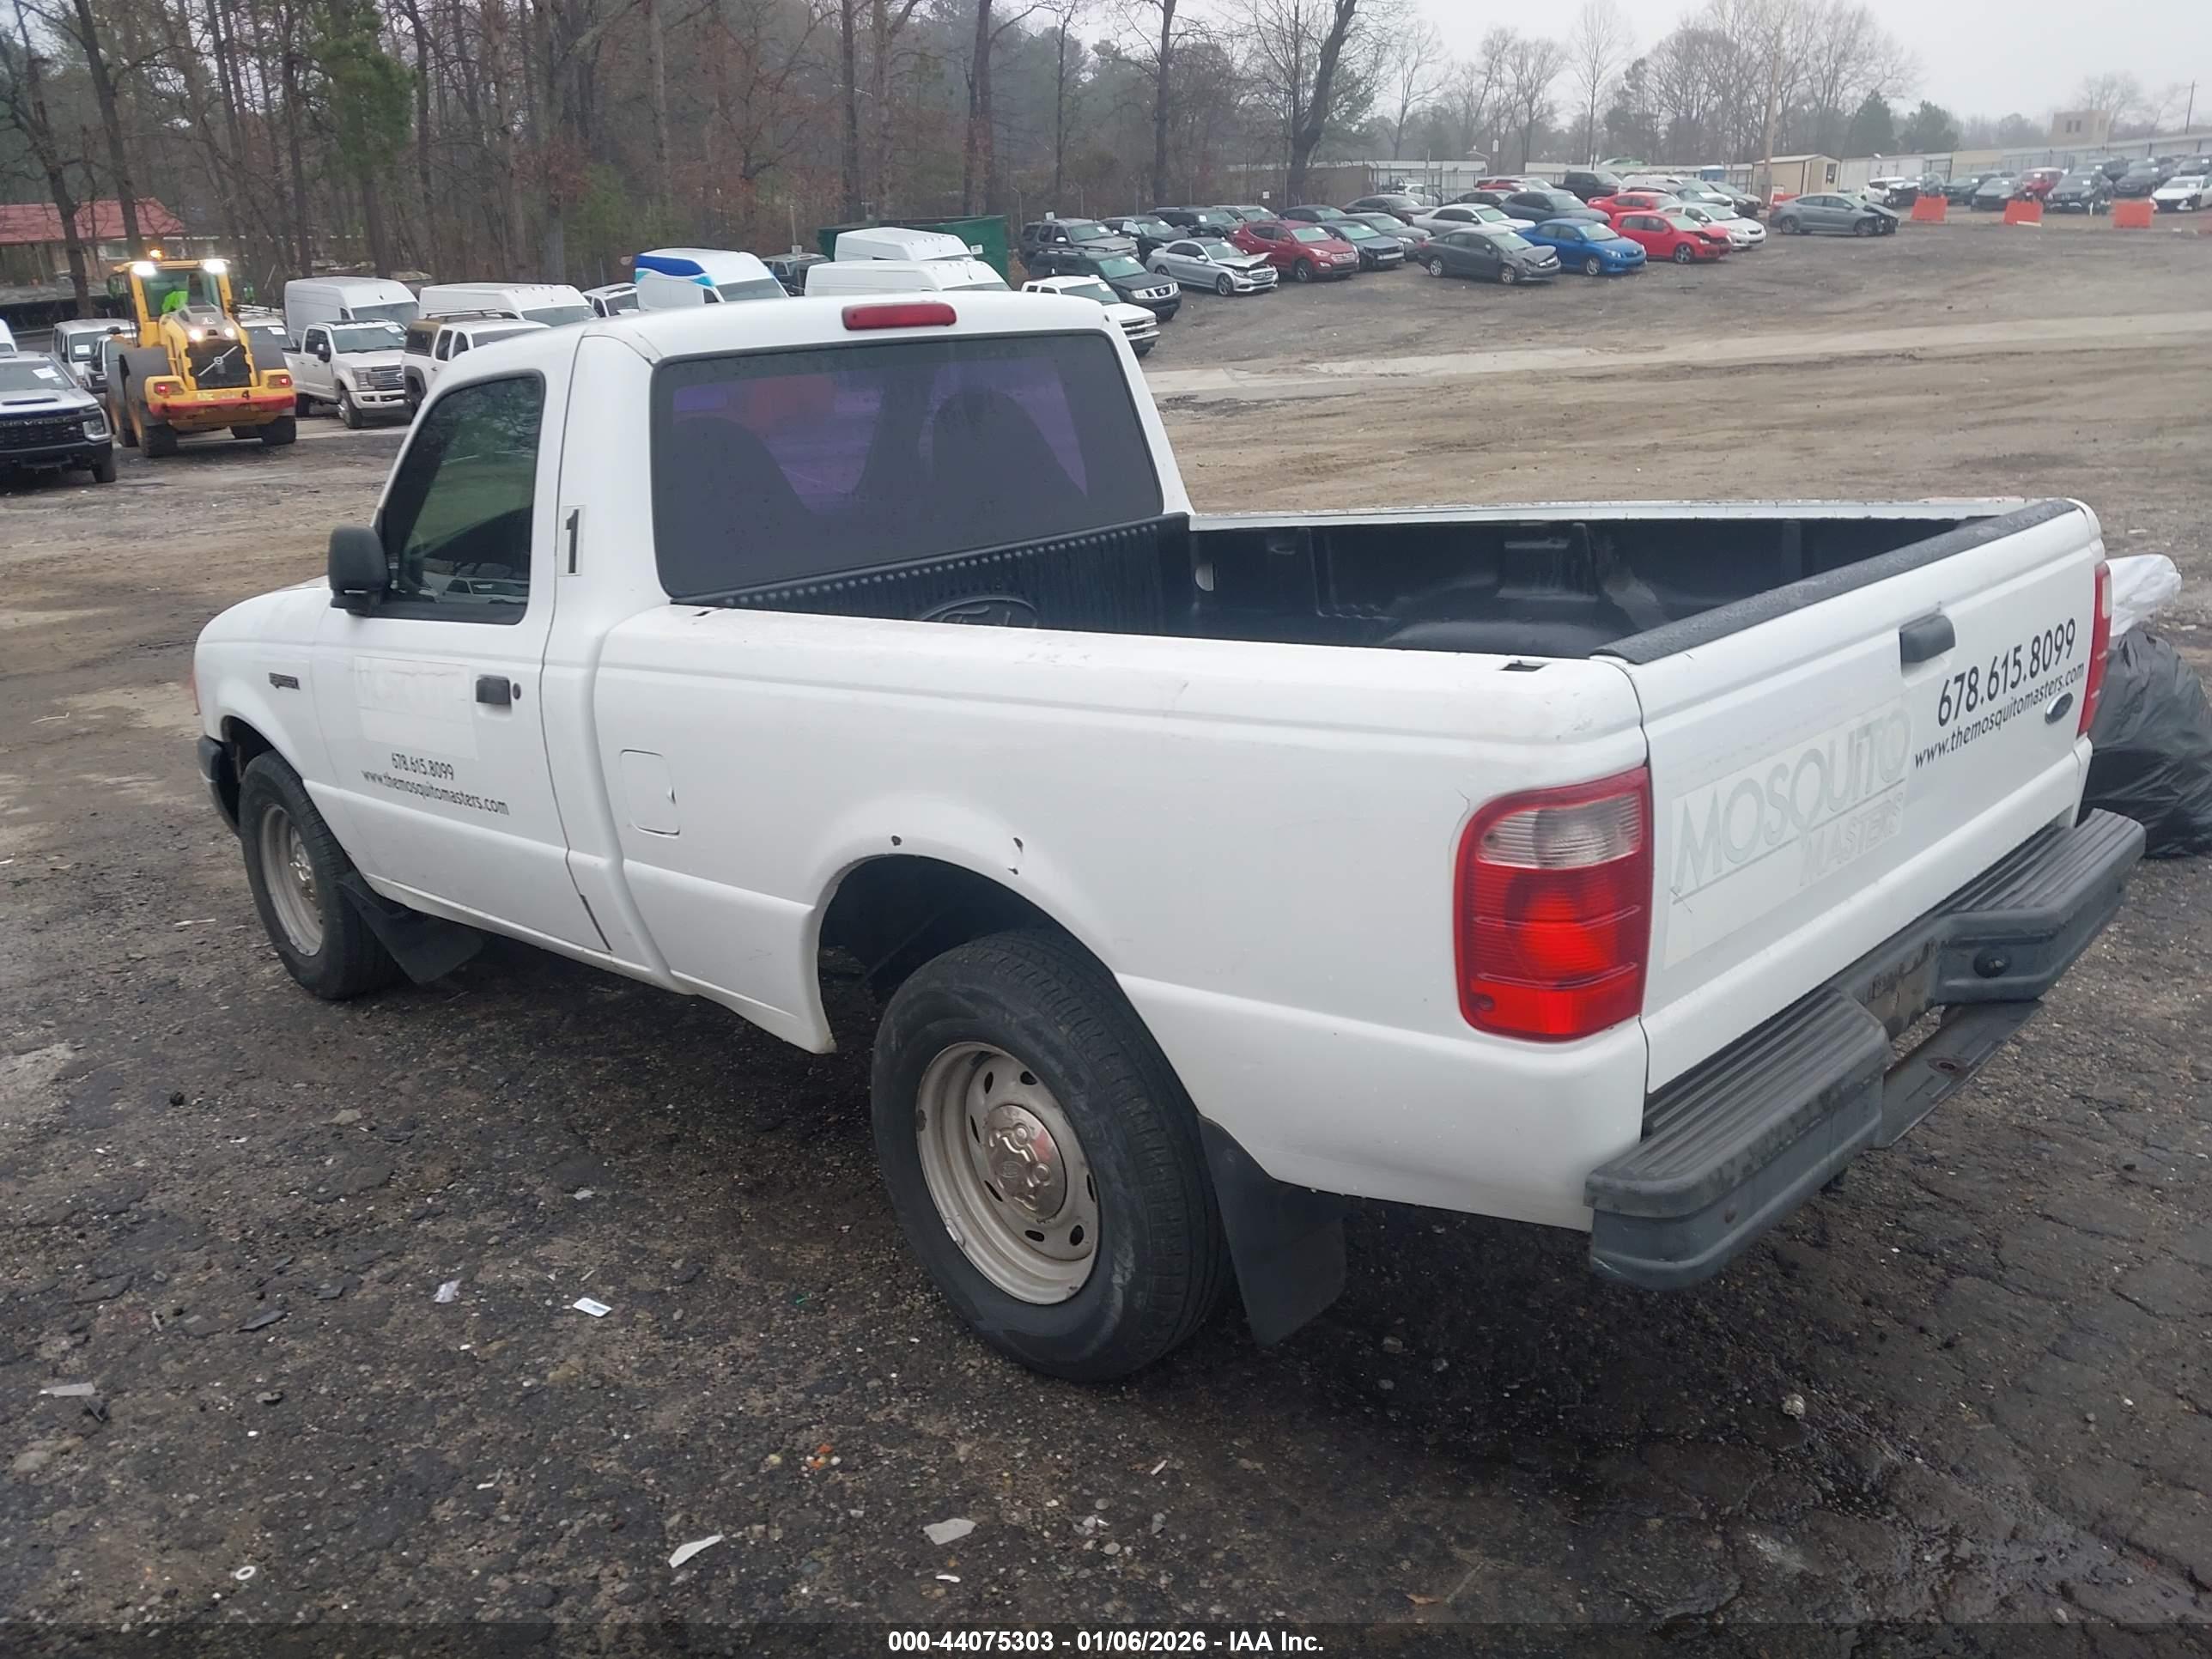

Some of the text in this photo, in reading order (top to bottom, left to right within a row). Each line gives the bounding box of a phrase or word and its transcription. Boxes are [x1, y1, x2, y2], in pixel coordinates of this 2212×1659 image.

[241, 390, 250, 400] 4
[566, 508, 579, 574] 1
[1938, 617, 2075, 726] 678.615.8099
[1915, 663, 2085, 769] www.themosquitomasters.com
[361, 770, 509, 816] www.themosquitomasters.com
[392, 752, 454, 781] 678.615.8099
